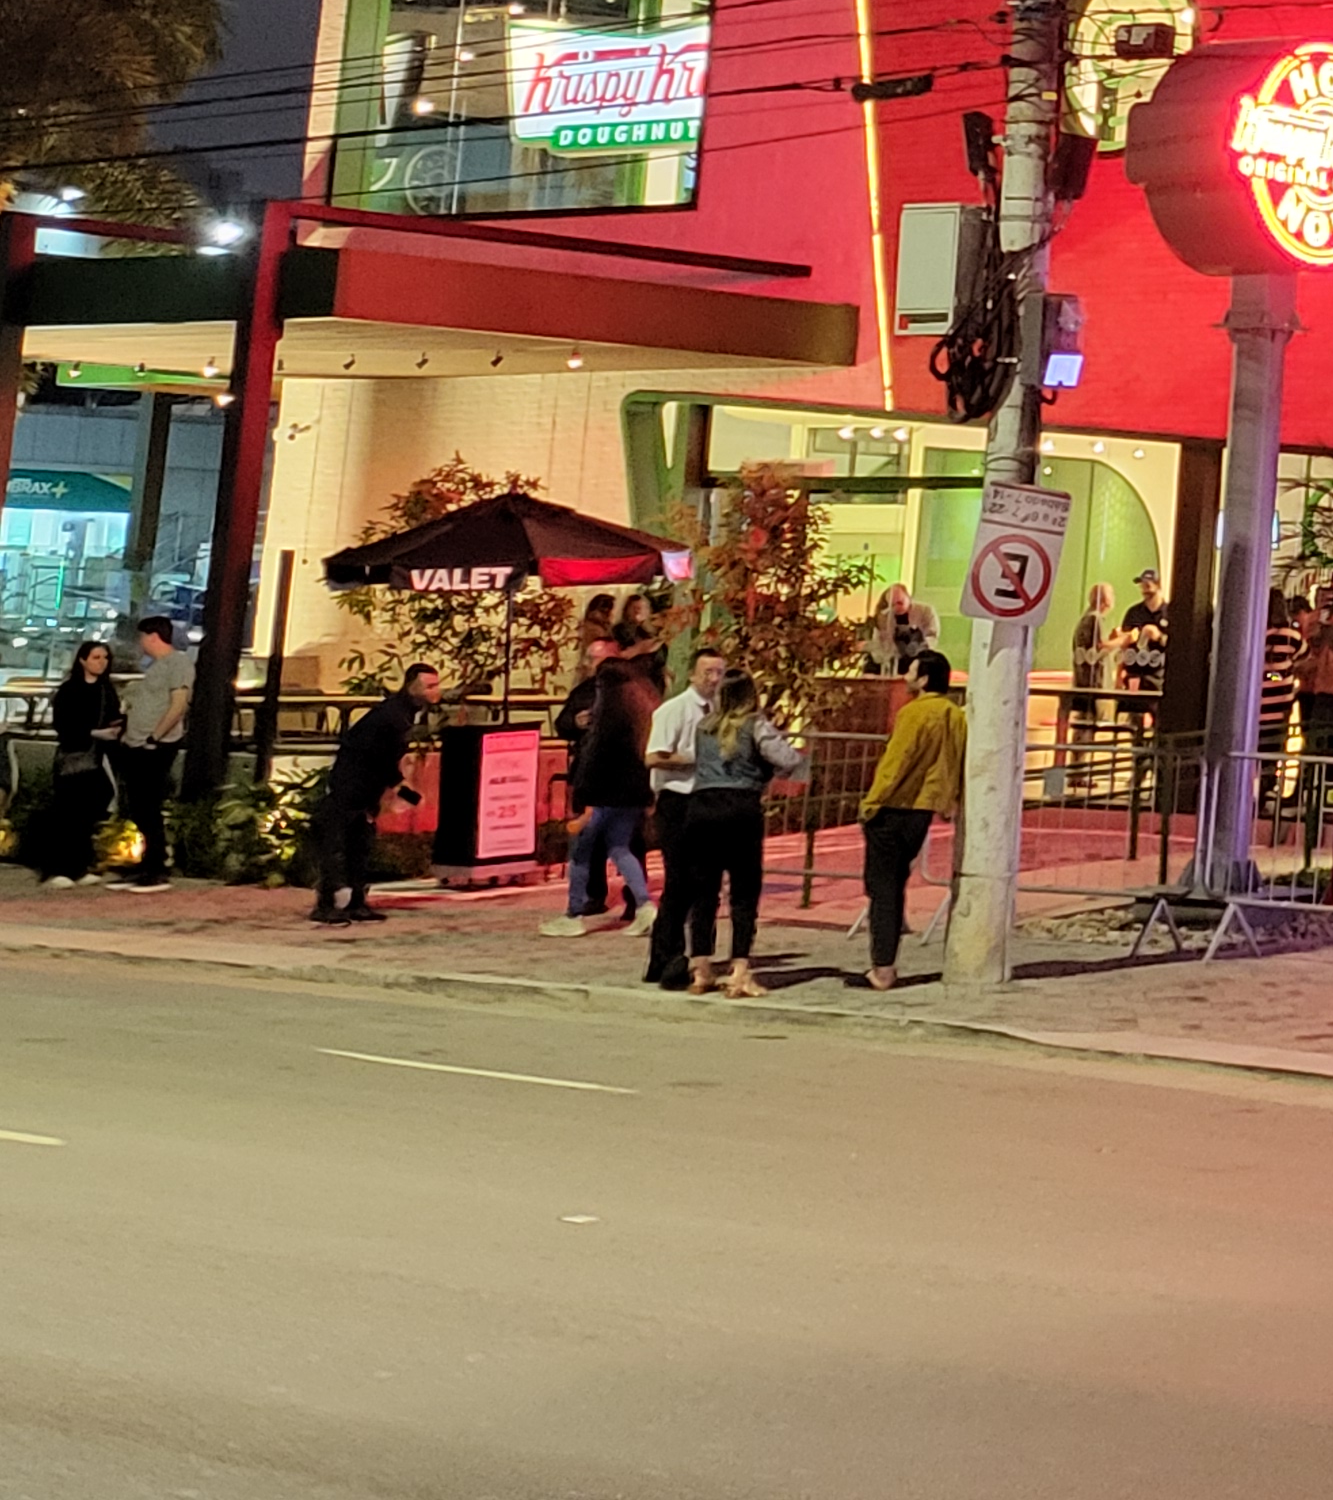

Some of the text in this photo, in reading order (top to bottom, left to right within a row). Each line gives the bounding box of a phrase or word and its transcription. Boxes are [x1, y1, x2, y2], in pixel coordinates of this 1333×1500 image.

[522, 45, 651, 117] Krispy
[1237, 154, 1330, 192] ORIGINAL
[410, 566, 513, 591] VALET
